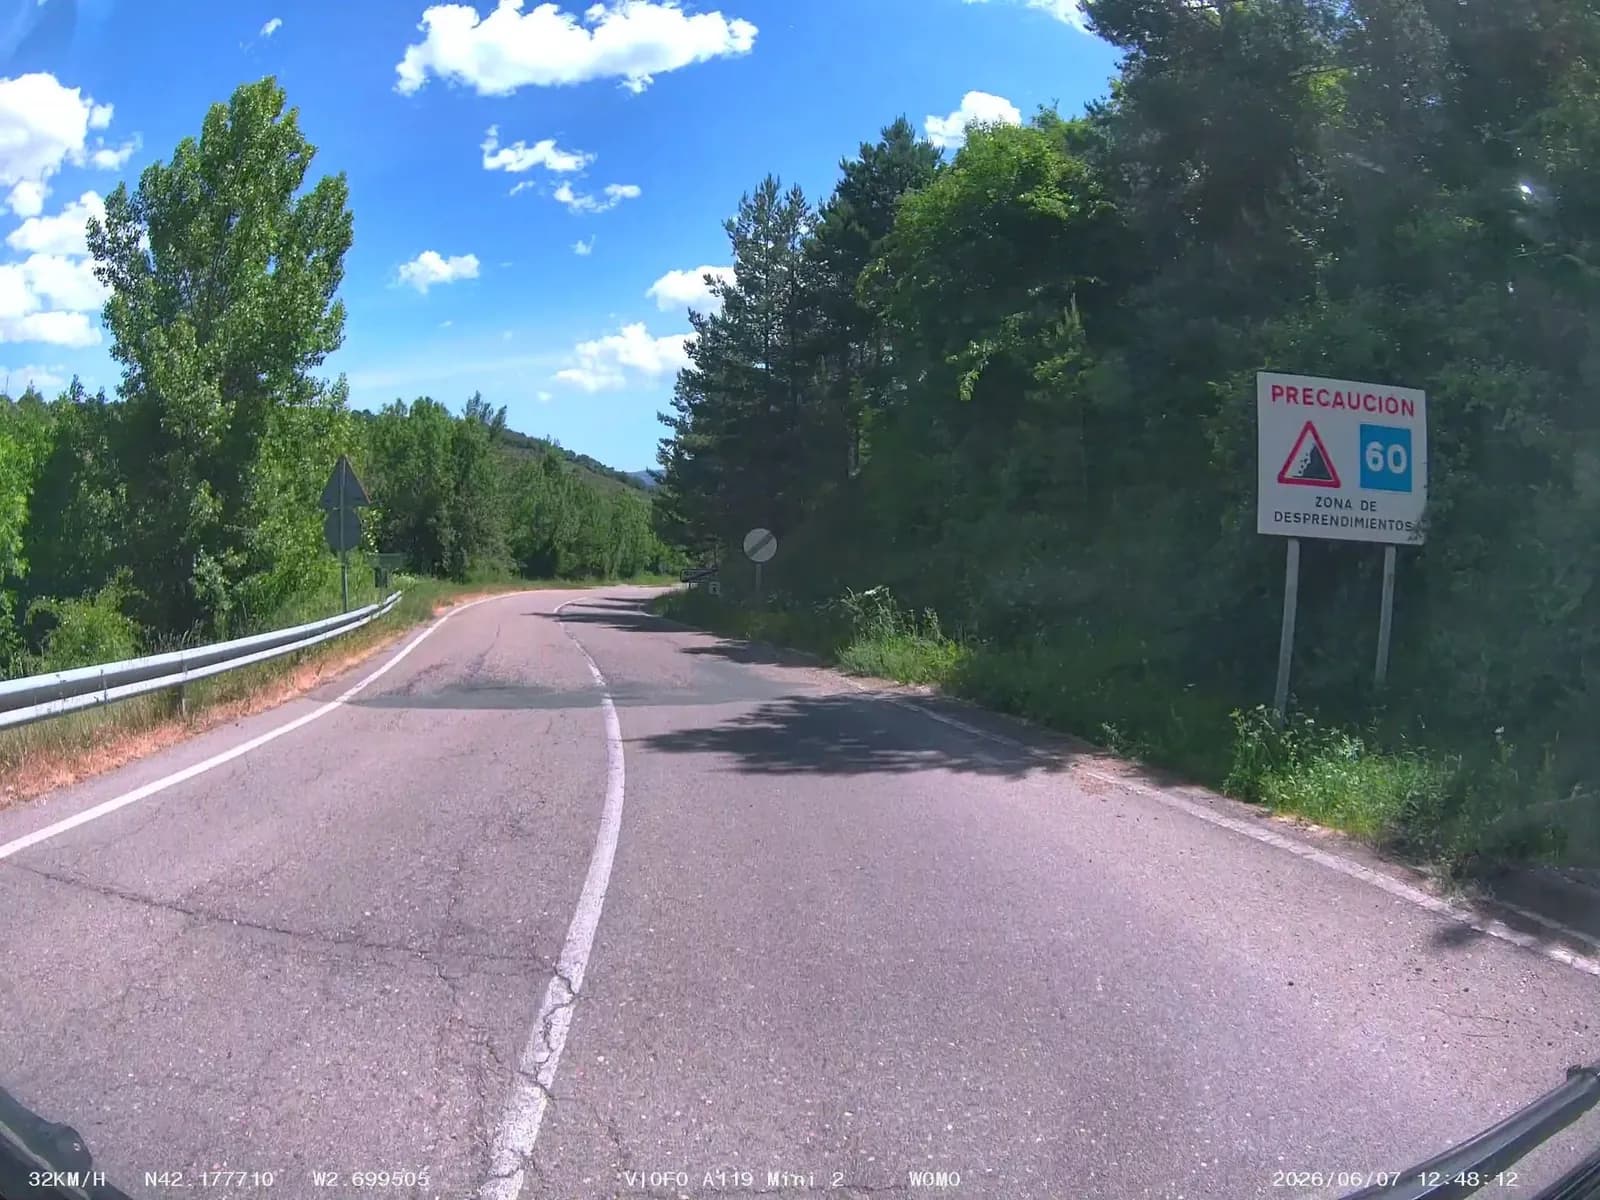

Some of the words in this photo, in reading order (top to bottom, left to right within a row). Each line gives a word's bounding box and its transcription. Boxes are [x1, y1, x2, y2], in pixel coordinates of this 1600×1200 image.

[1365, 441, 1408, 474] 60
[1315, 496, 1352, 509] ZONA
[1360, 500, 1377, 512] DE
[1274, 511, 1413, 531] DESPRENDIMIENTOS
